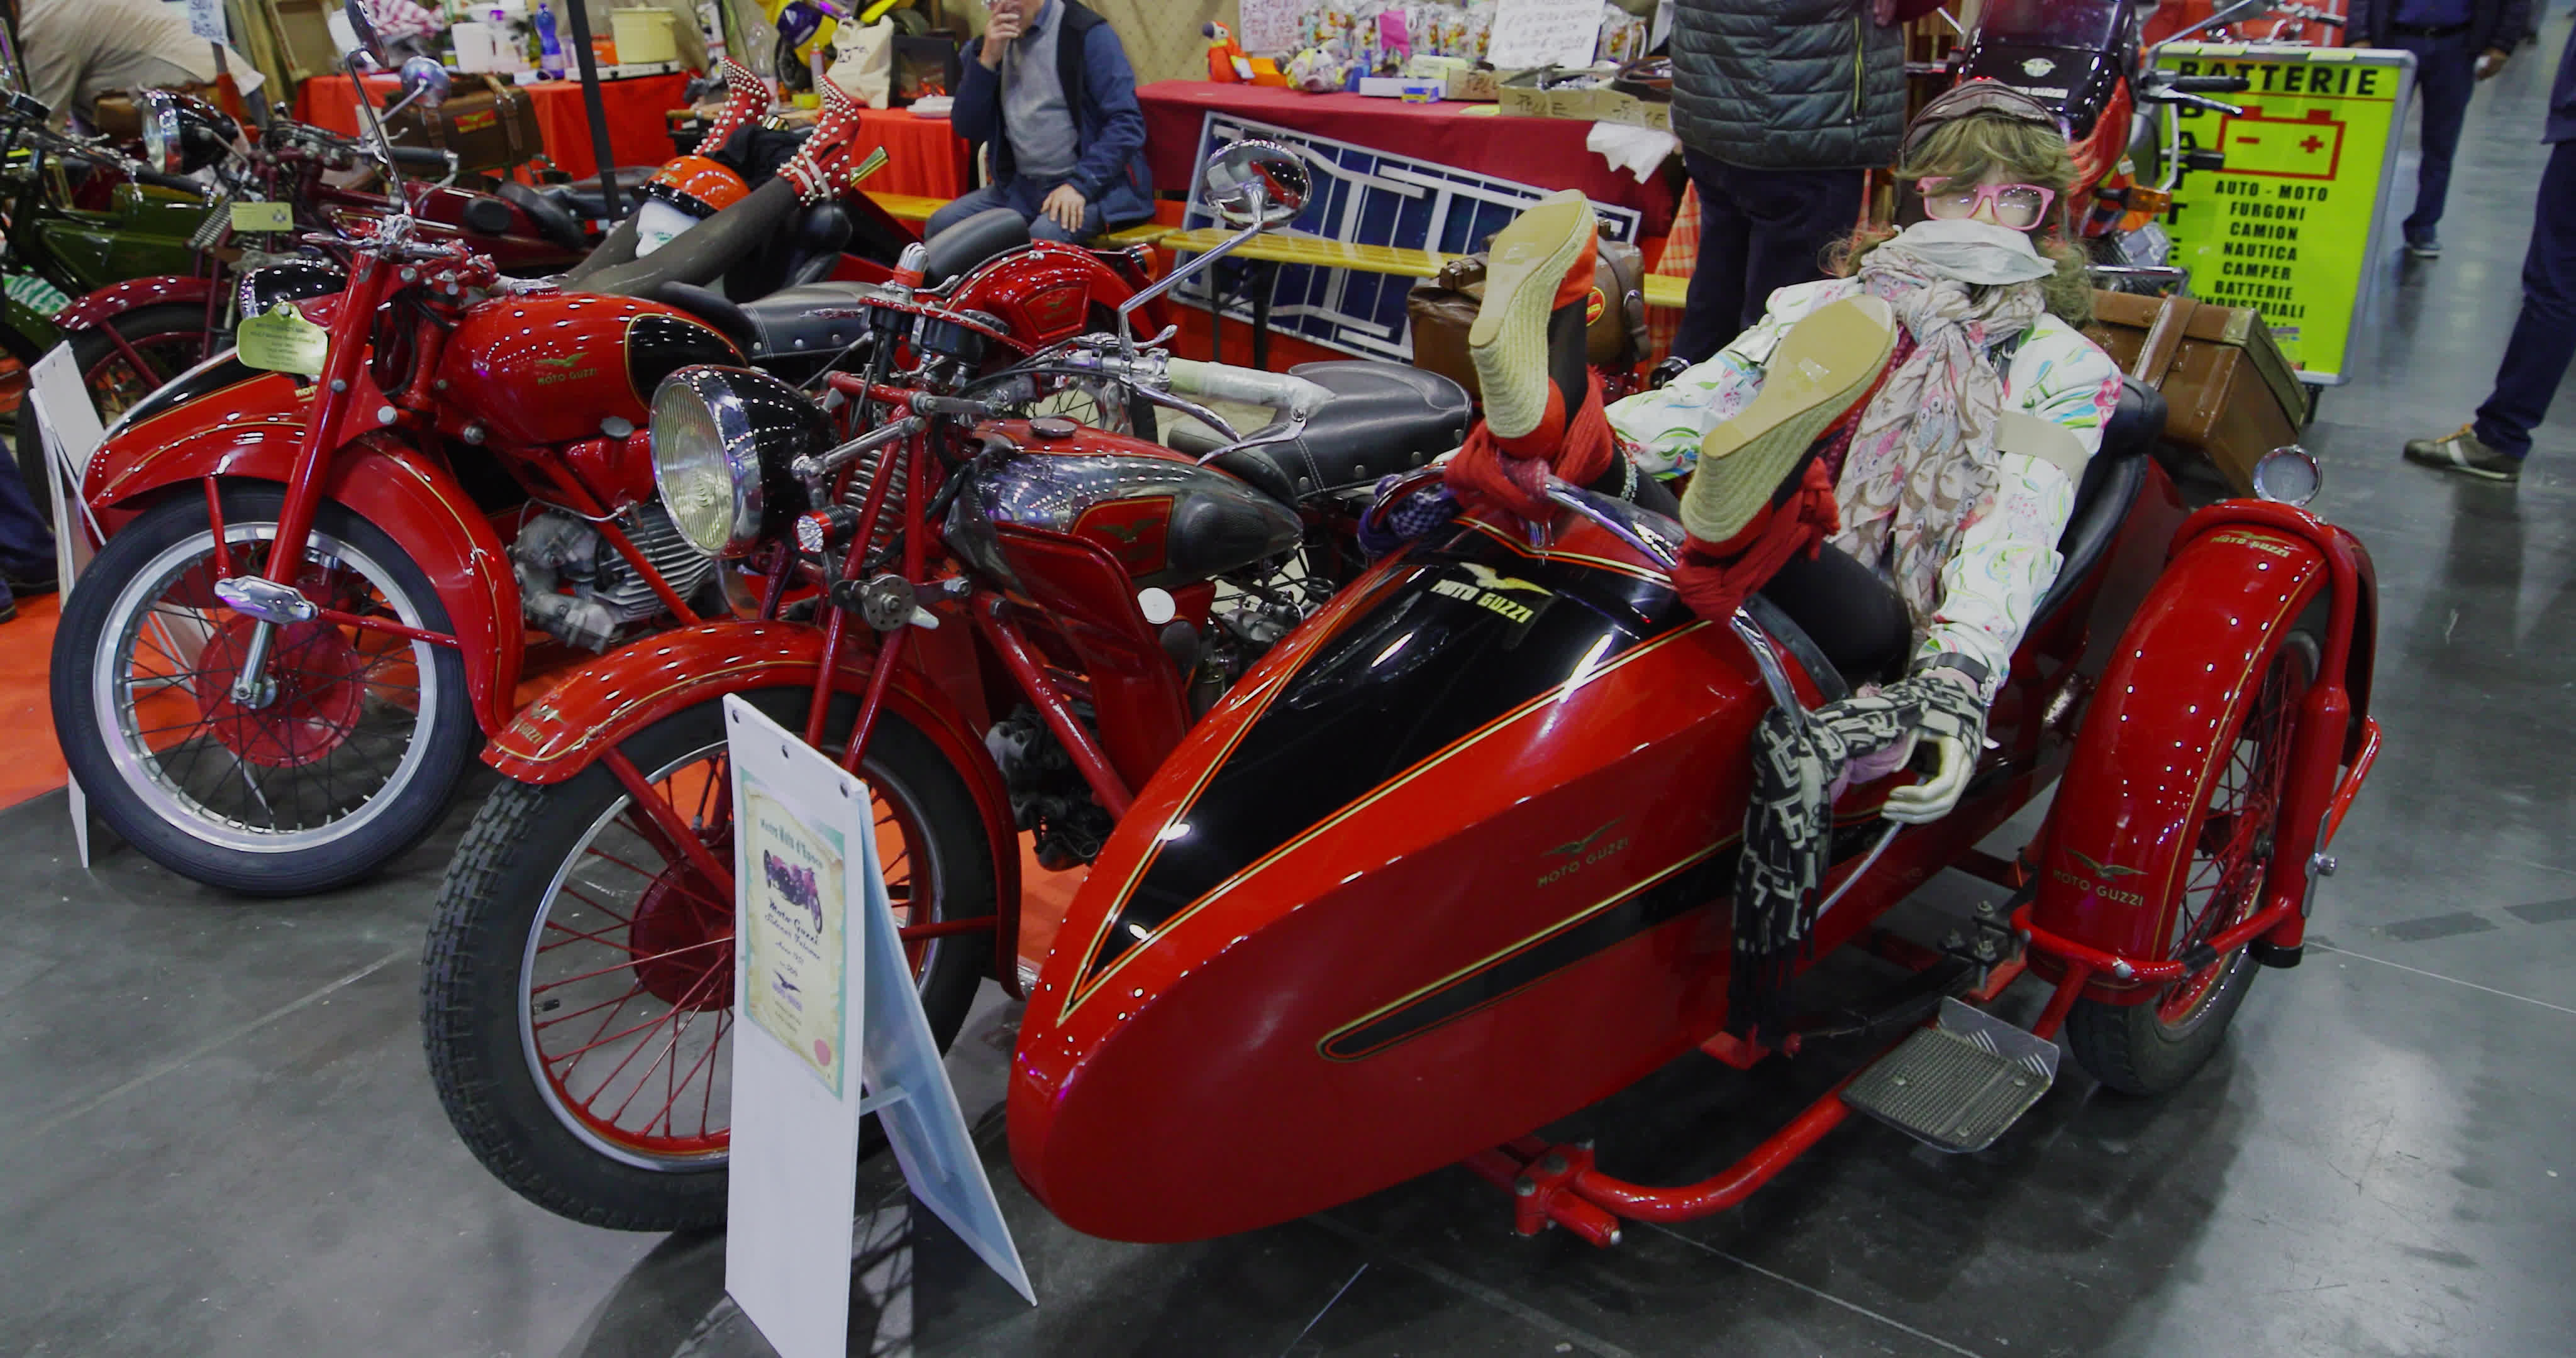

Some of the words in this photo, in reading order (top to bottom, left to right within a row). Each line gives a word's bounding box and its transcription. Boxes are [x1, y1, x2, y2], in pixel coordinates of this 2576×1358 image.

[2178, 60, 2378, 95] BATTERIE
[2214, 180, 2259, 197] AUTO
[2279, 184, 2328, 202] MOTO
[2230, 201, 2306, 221] FURGONI
[2229, 221, 2299, 241] CAMION
[2223, 241, 2298, 262] NAUTICA
[2223, 261, 2292, 281] CAMPER
[2214, 280, 2294, 301] BATTERIE
[2211, 536, 2246, 545] MOTO
[2250, 541, 2291, 558] GUZZI
[1430, 578, 1480, 602] MOTO
[1476, 592, 1535, 624] GUZZI
[1536, 860, 1580, 888] MOTO
[1585, 837, 1629, 864] GUZZI
[2052, 868, 2090, 891] MOTO
[2096, 885, 2145, 907] GUZZI
